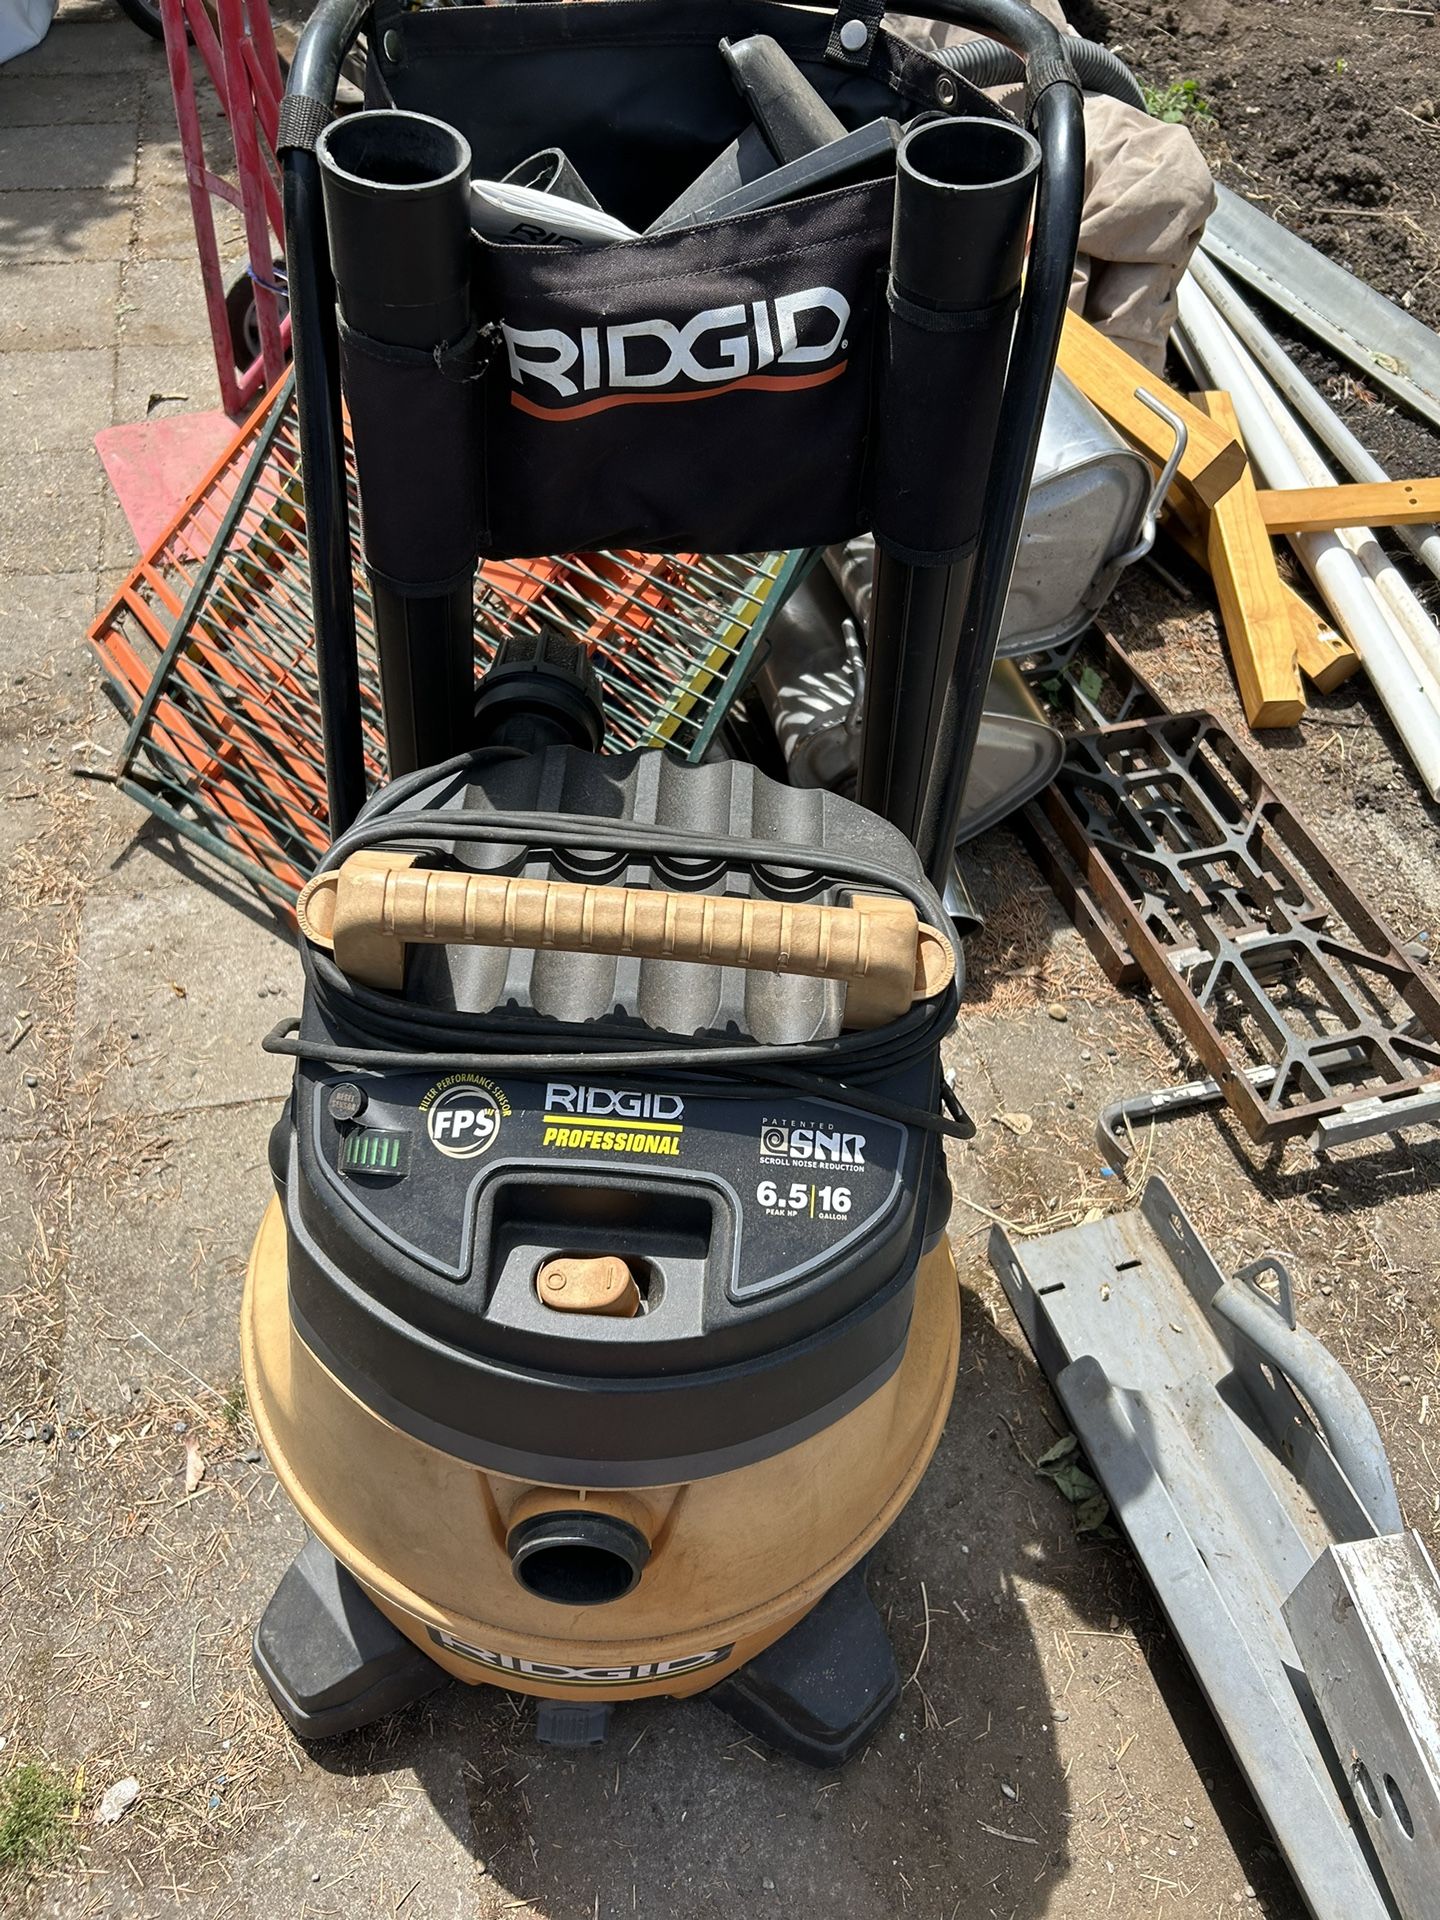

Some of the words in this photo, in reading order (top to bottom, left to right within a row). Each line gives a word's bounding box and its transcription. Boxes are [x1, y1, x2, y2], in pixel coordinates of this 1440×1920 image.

[501, 286, 850, 397] RIDGID
[418, 1087, 439, 1112] FILTER
[436, 1073, 495, 1091] PERFORMANCE
[492, 1086, 513, 1117] SENSOR
[545, 1083, 684, 1119] RIDGID
[433, 1109, 495, 1139] FPS
[762, 1117, 834, 1130] PATENTED
[543, 1127, 680, 1155] PROFESSIONAL
[790, 1129, 866, 1164] SNR
[760, 1156, 790, 1166] SCROLL
[792, 1159, 817, 1169] NOISE
[819, 1161, 865, 1172] REDUCTION
[756, 1181, 808, 1209] 6.5
[818, 1186, 852, 1213] 16
[766, 1208, 785, 1216] PEAK
[818, 1213, 848, 1222] GALLON
[440, 1631, 718, 1680] RIDGID
